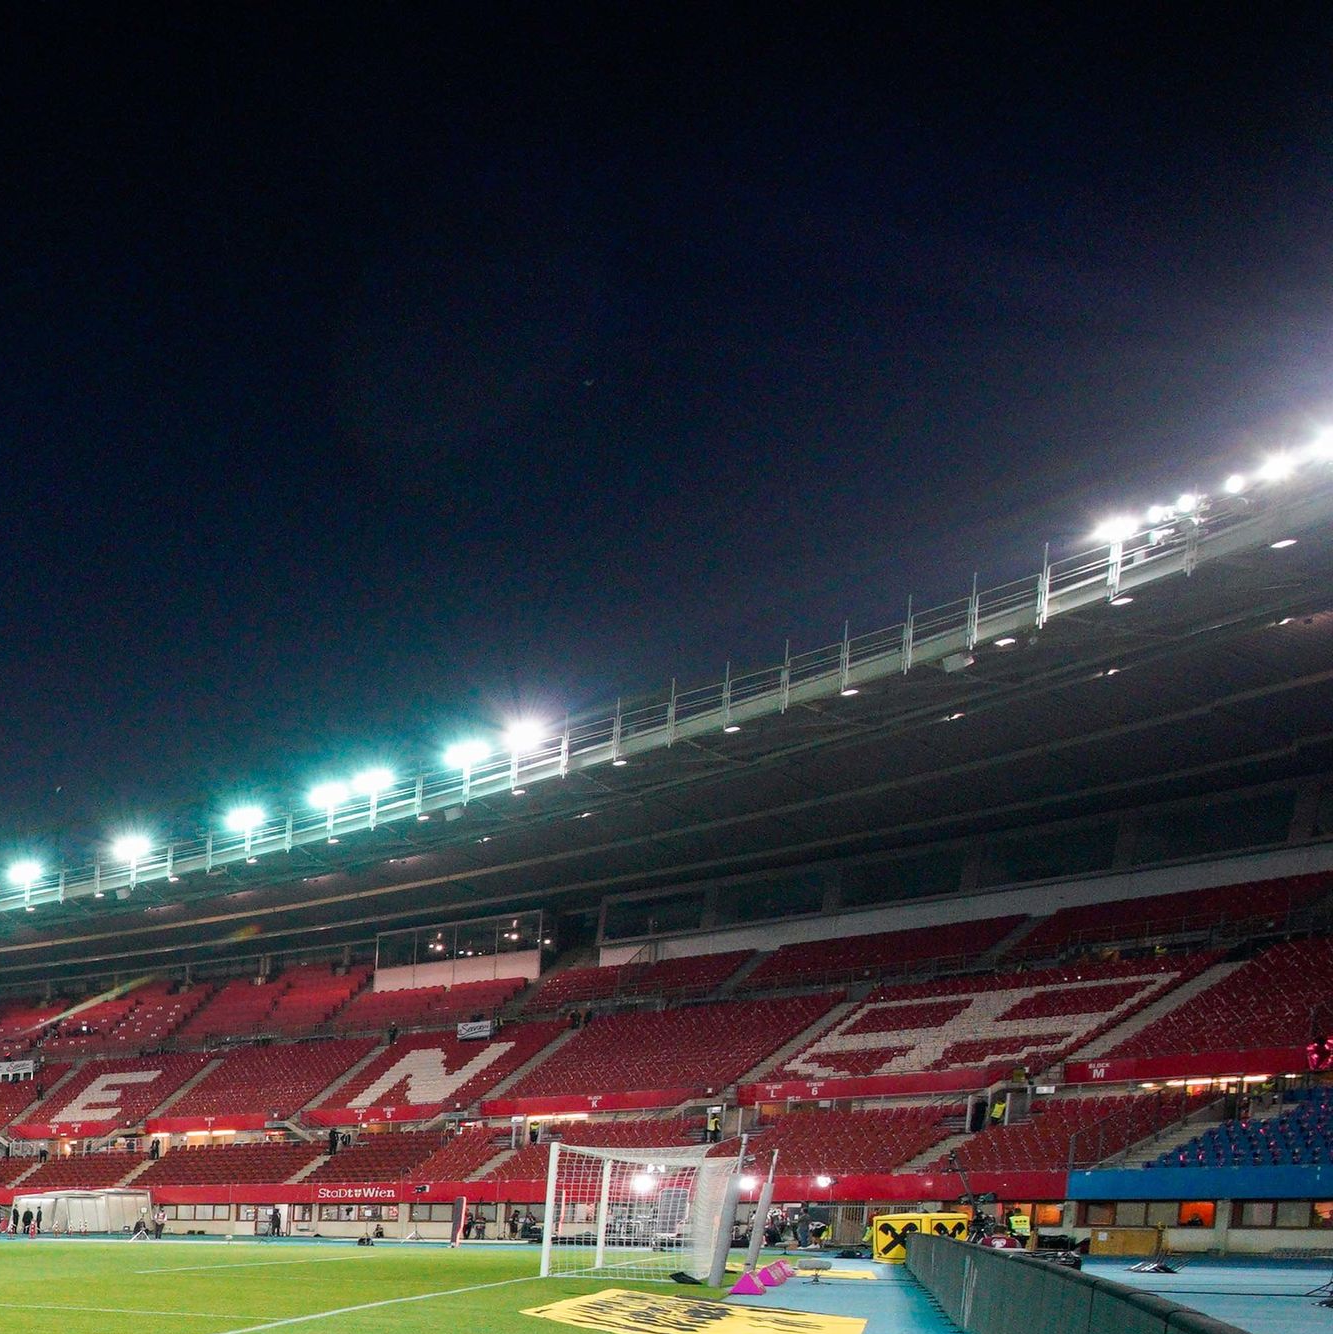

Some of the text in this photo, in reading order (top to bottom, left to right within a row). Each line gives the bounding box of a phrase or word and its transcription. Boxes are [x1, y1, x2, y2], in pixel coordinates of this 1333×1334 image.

[1093, 1069, 1104, 1078] M
[770, 1090, 776, 1098] L
[591, 1100, 598, 1108] K
[363, 1187, 395, 1198] Wien
